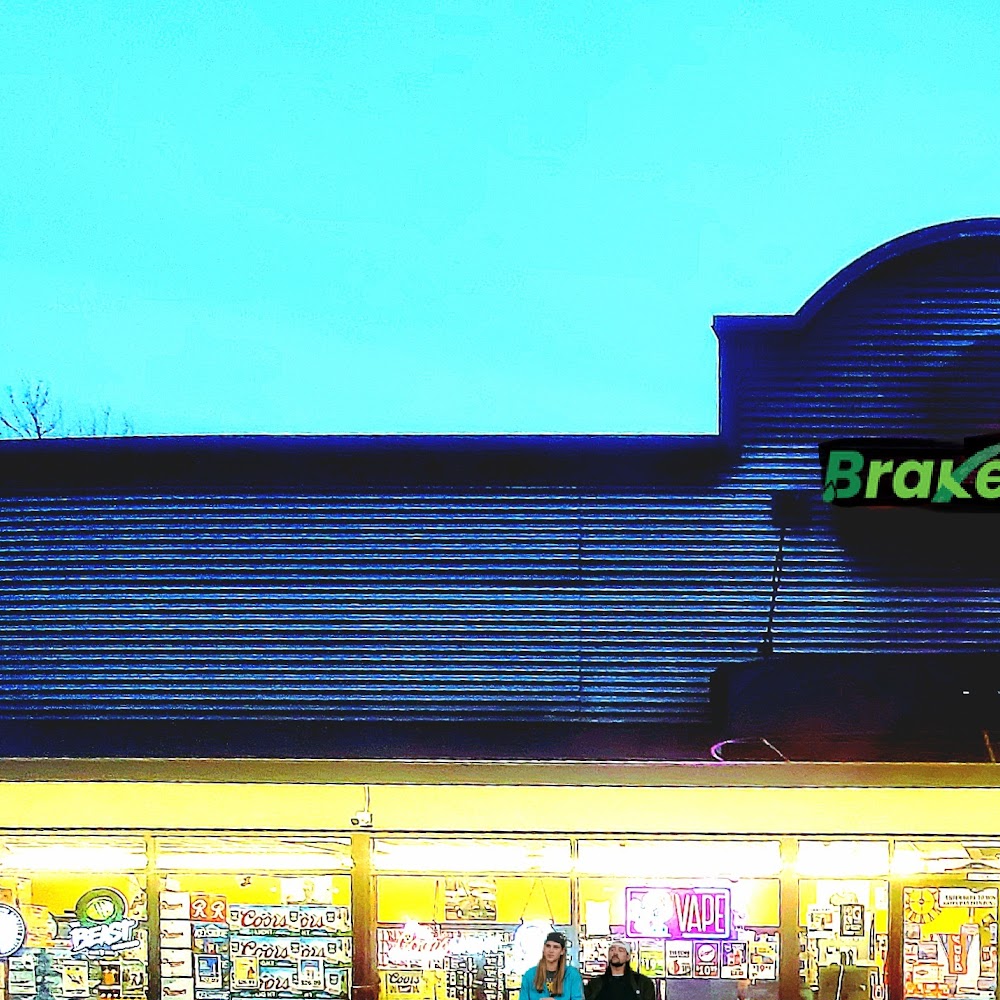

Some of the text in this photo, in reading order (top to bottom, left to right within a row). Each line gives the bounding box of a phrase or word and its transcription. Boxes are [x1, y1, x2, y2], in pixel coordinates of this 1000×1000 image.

[240, 909, 288, 928] Coors
[673, 892, 727, 934] VAPE
[241, 940, 289, 959] Coors
[388, 973, 421, 985] Coors
